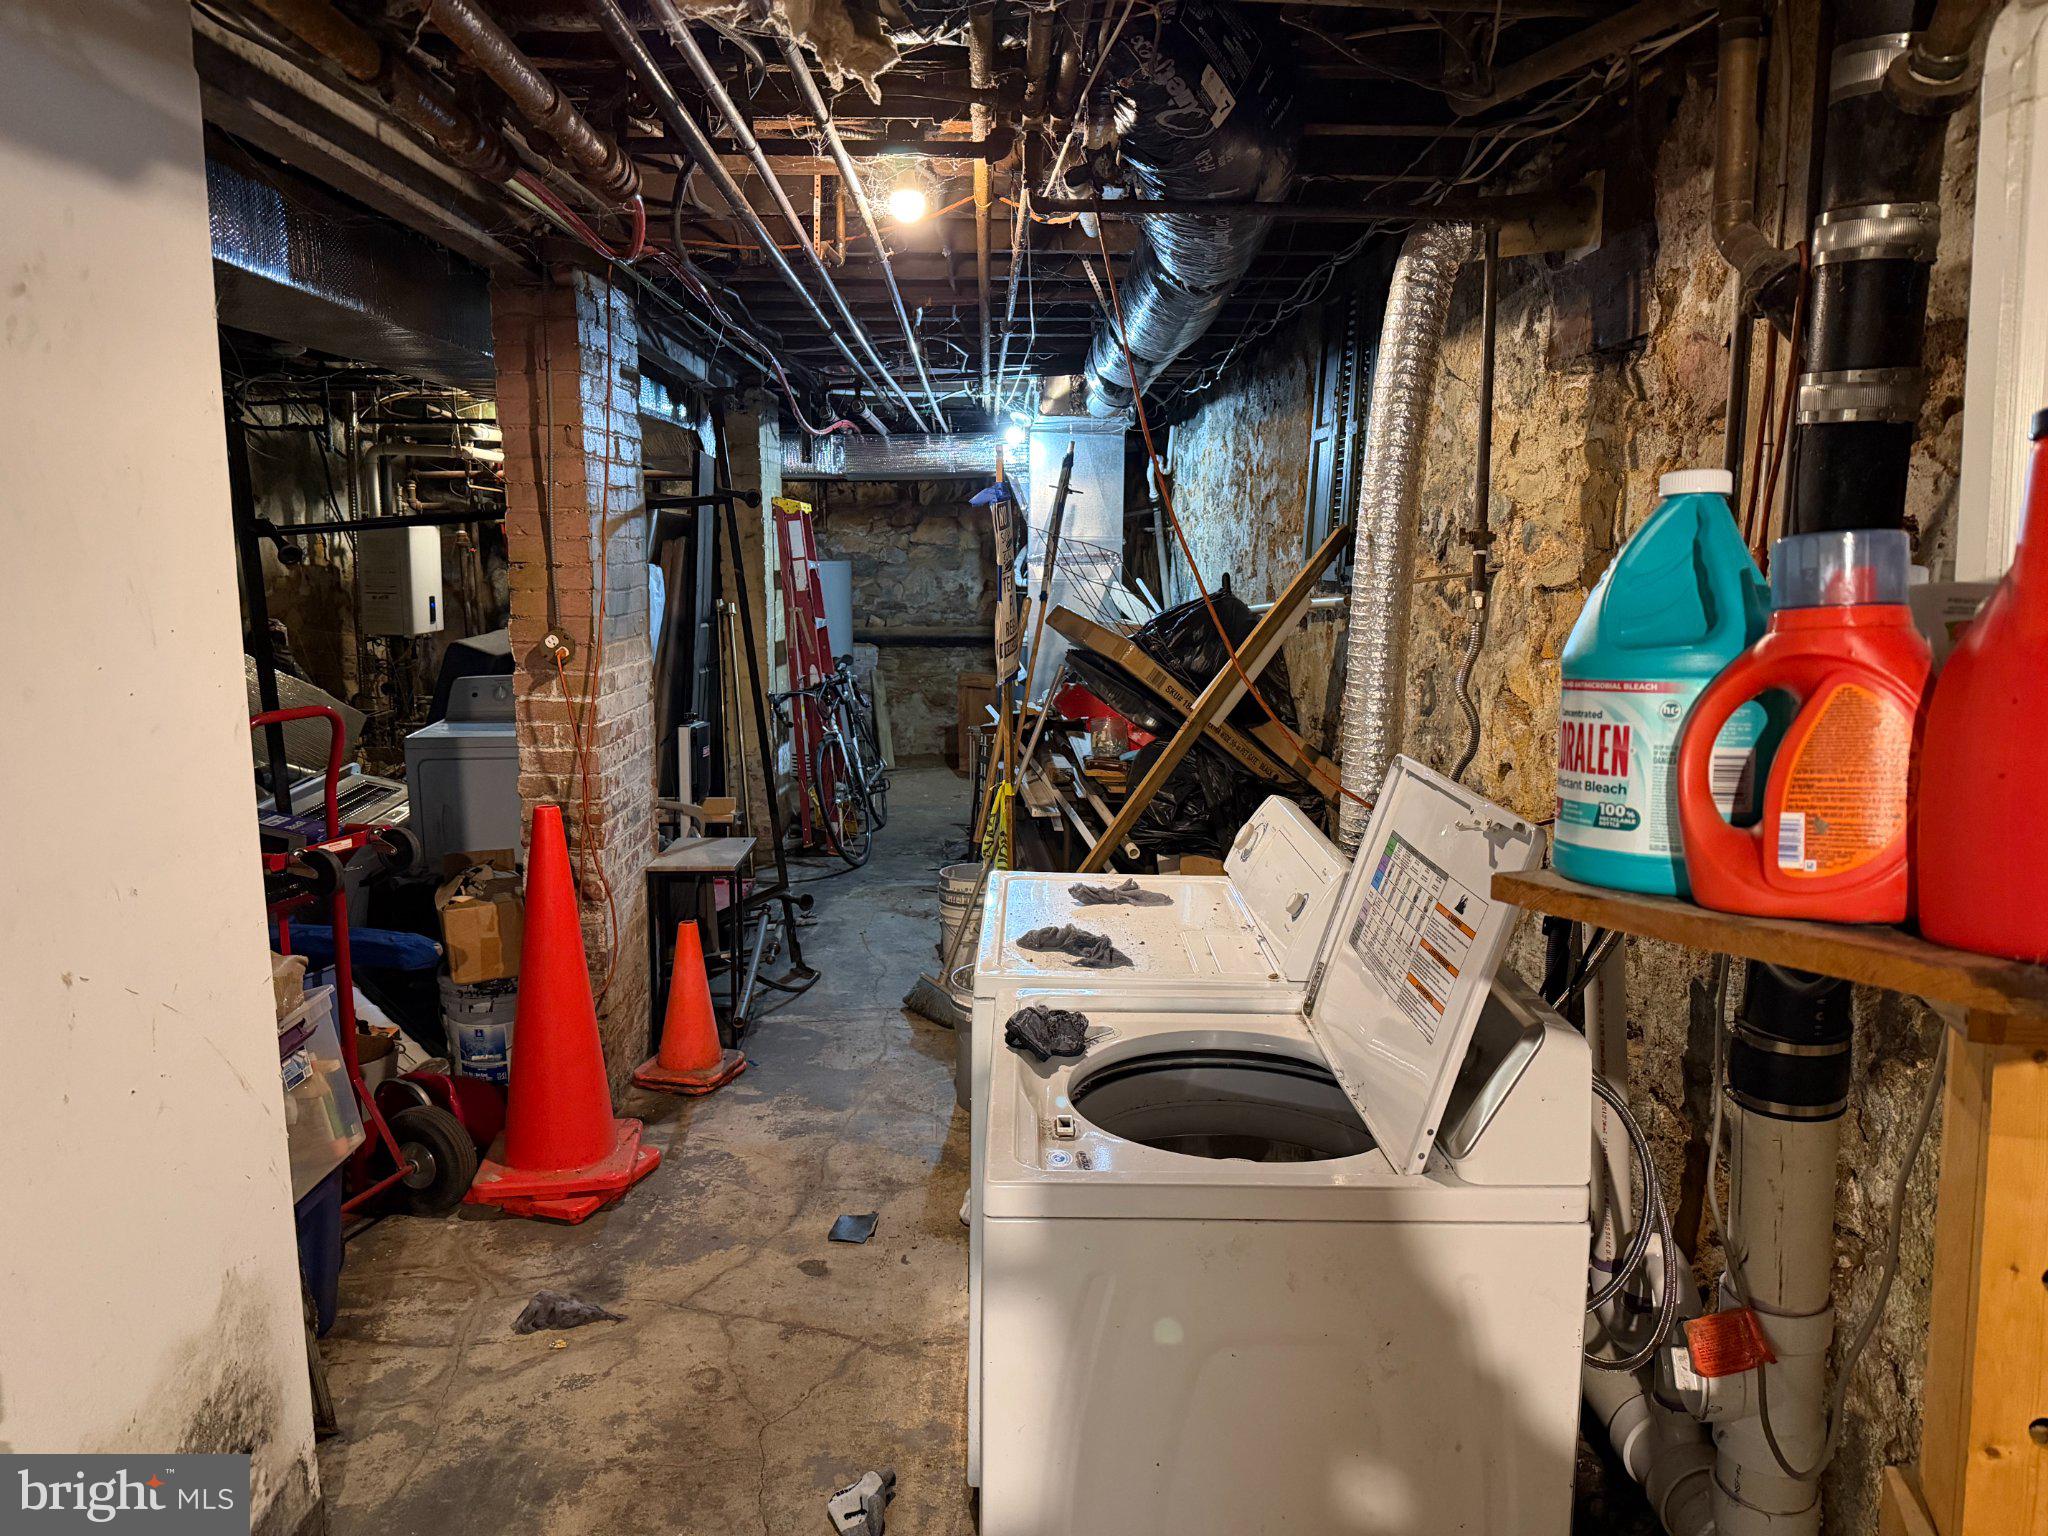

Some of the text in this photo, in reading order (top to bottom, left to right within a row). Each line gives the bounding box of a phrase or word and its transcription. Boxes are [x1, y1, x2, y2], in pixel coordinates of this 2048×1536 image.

[1165, 685, 1183, 701] SKU#
[1623, 682, 1658, 691] BLEACH
[1558, 720, 1630, 777] ORALEN
[1584, 780, 1628, 795] Bleach
[1599, 802, 1636, 818] 100%
